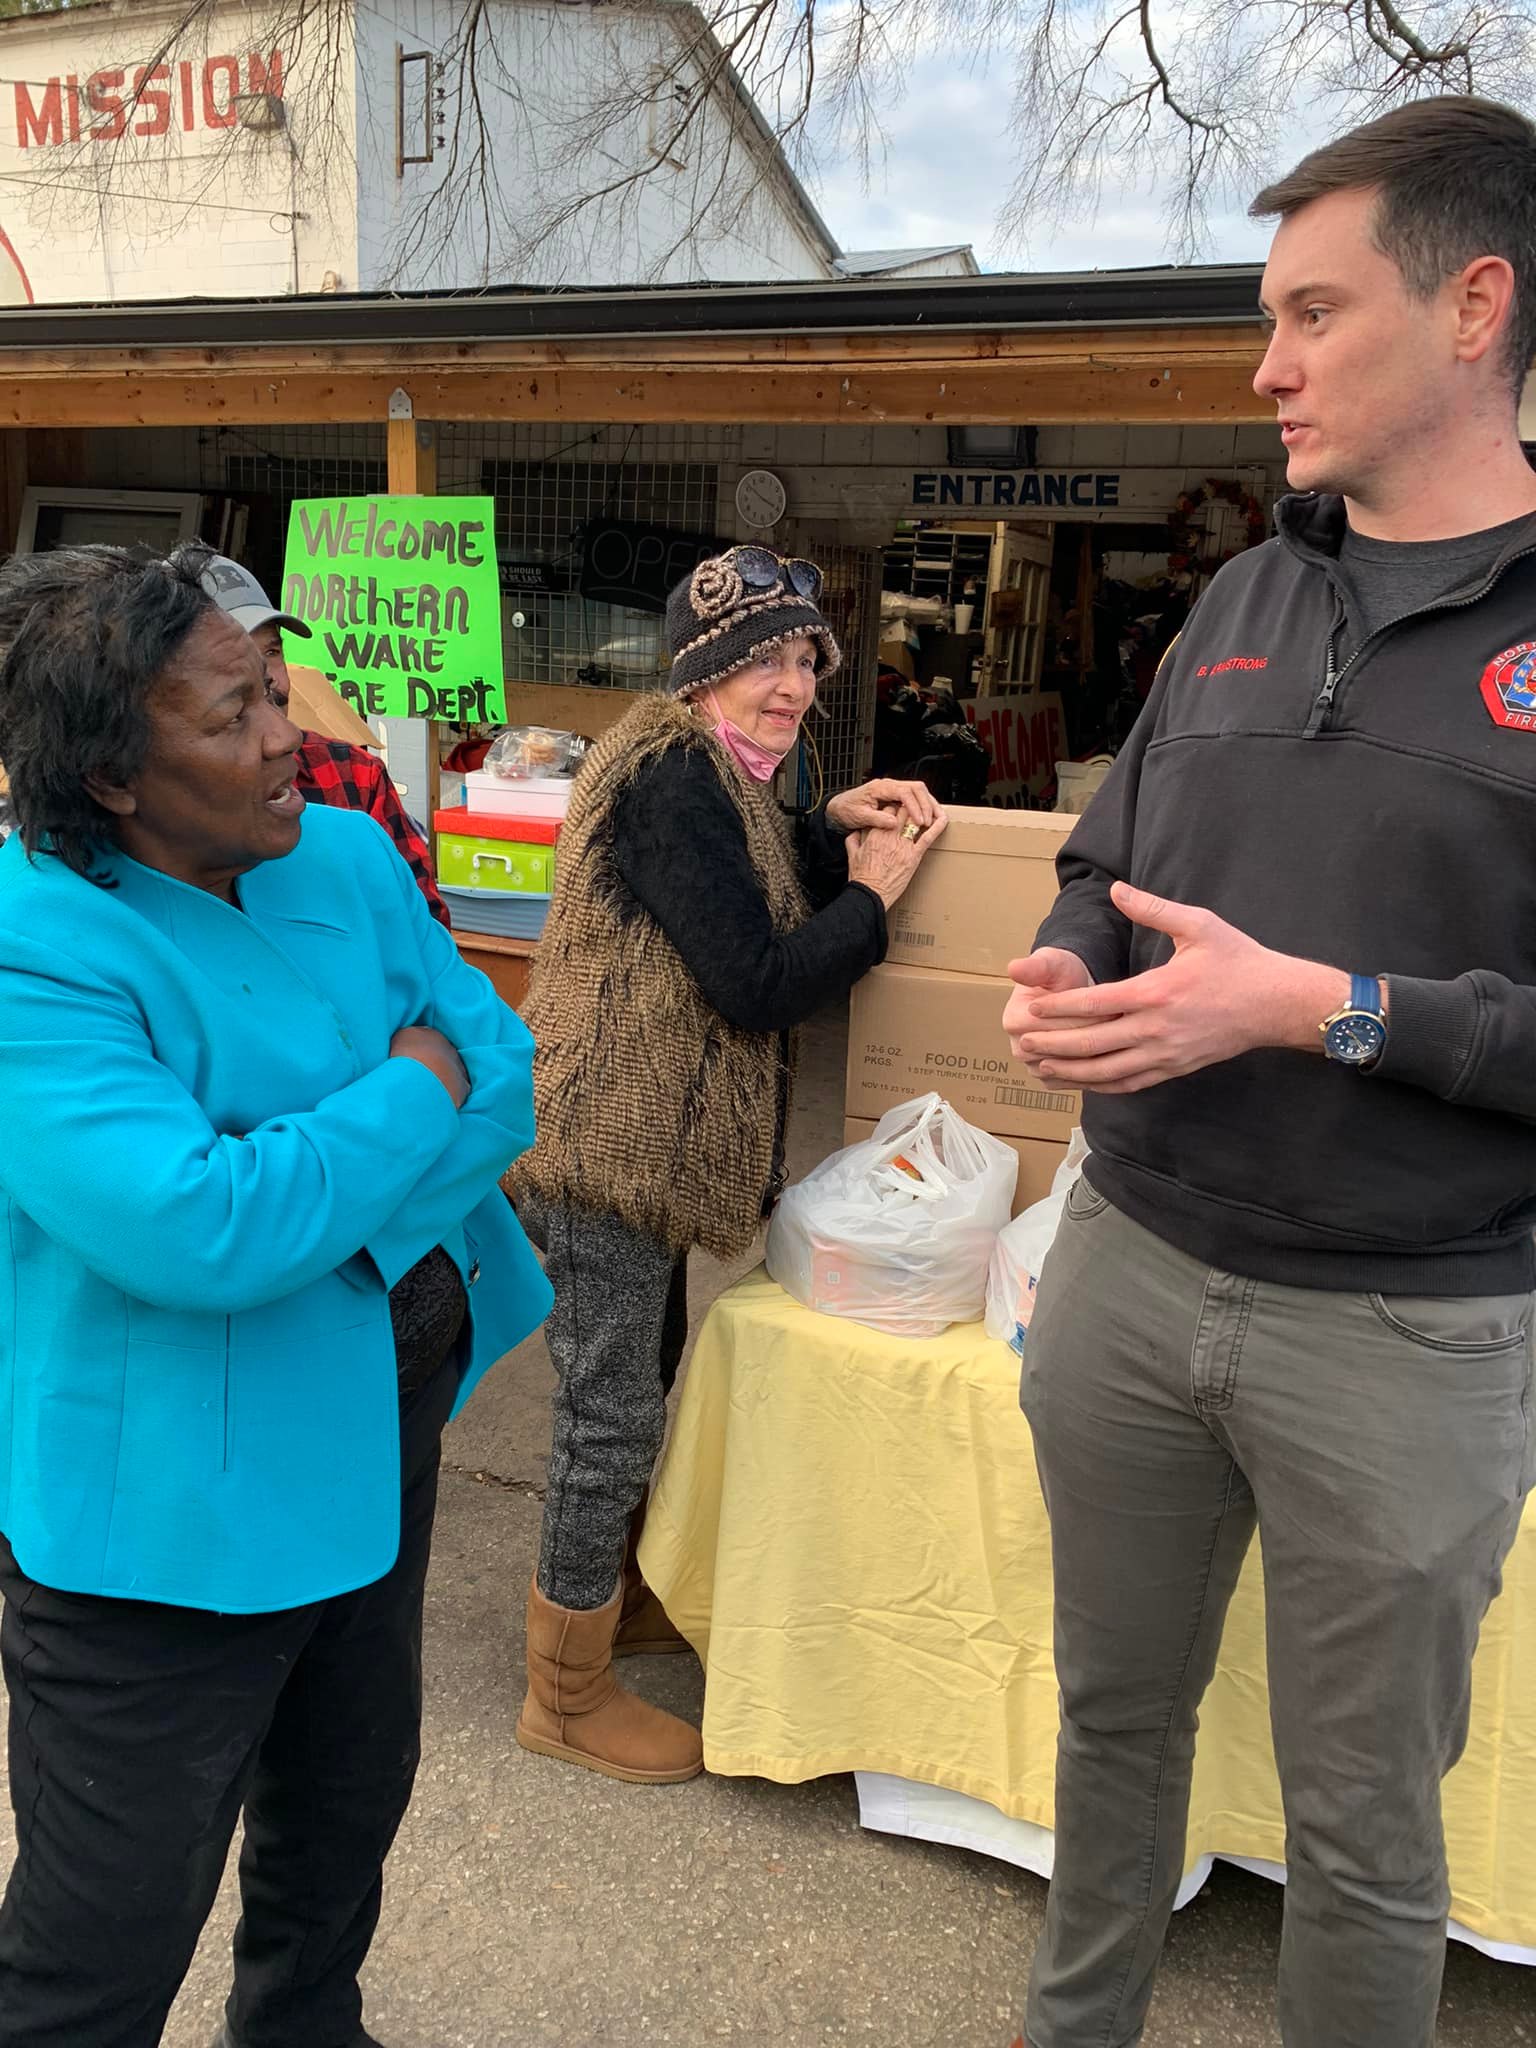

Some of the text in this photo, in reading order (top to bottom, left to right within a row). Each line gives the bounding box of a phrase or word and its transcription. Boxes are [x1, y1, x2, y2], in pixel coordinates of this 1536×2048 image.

[14, 49, 283, 149] MISSION
[912, 473, 1120, 506] ENTRANCE
[323, 632, 448, 673] WAKE
[325, 672, 388, 724] RE
[865, 1044, 904, 1057] 12-6 OZ.
[925, 1052, 1009, 1074] FOOD LION
[861, 1081, 879, 1089] NOV
[913, 1067, 935, 1076] STEP
[936, 1069, 969, 1080] TURKEY
[969, 1073, 1010, 1086] STUFFING
[1011, 1078, 1026, 1087] MIX
